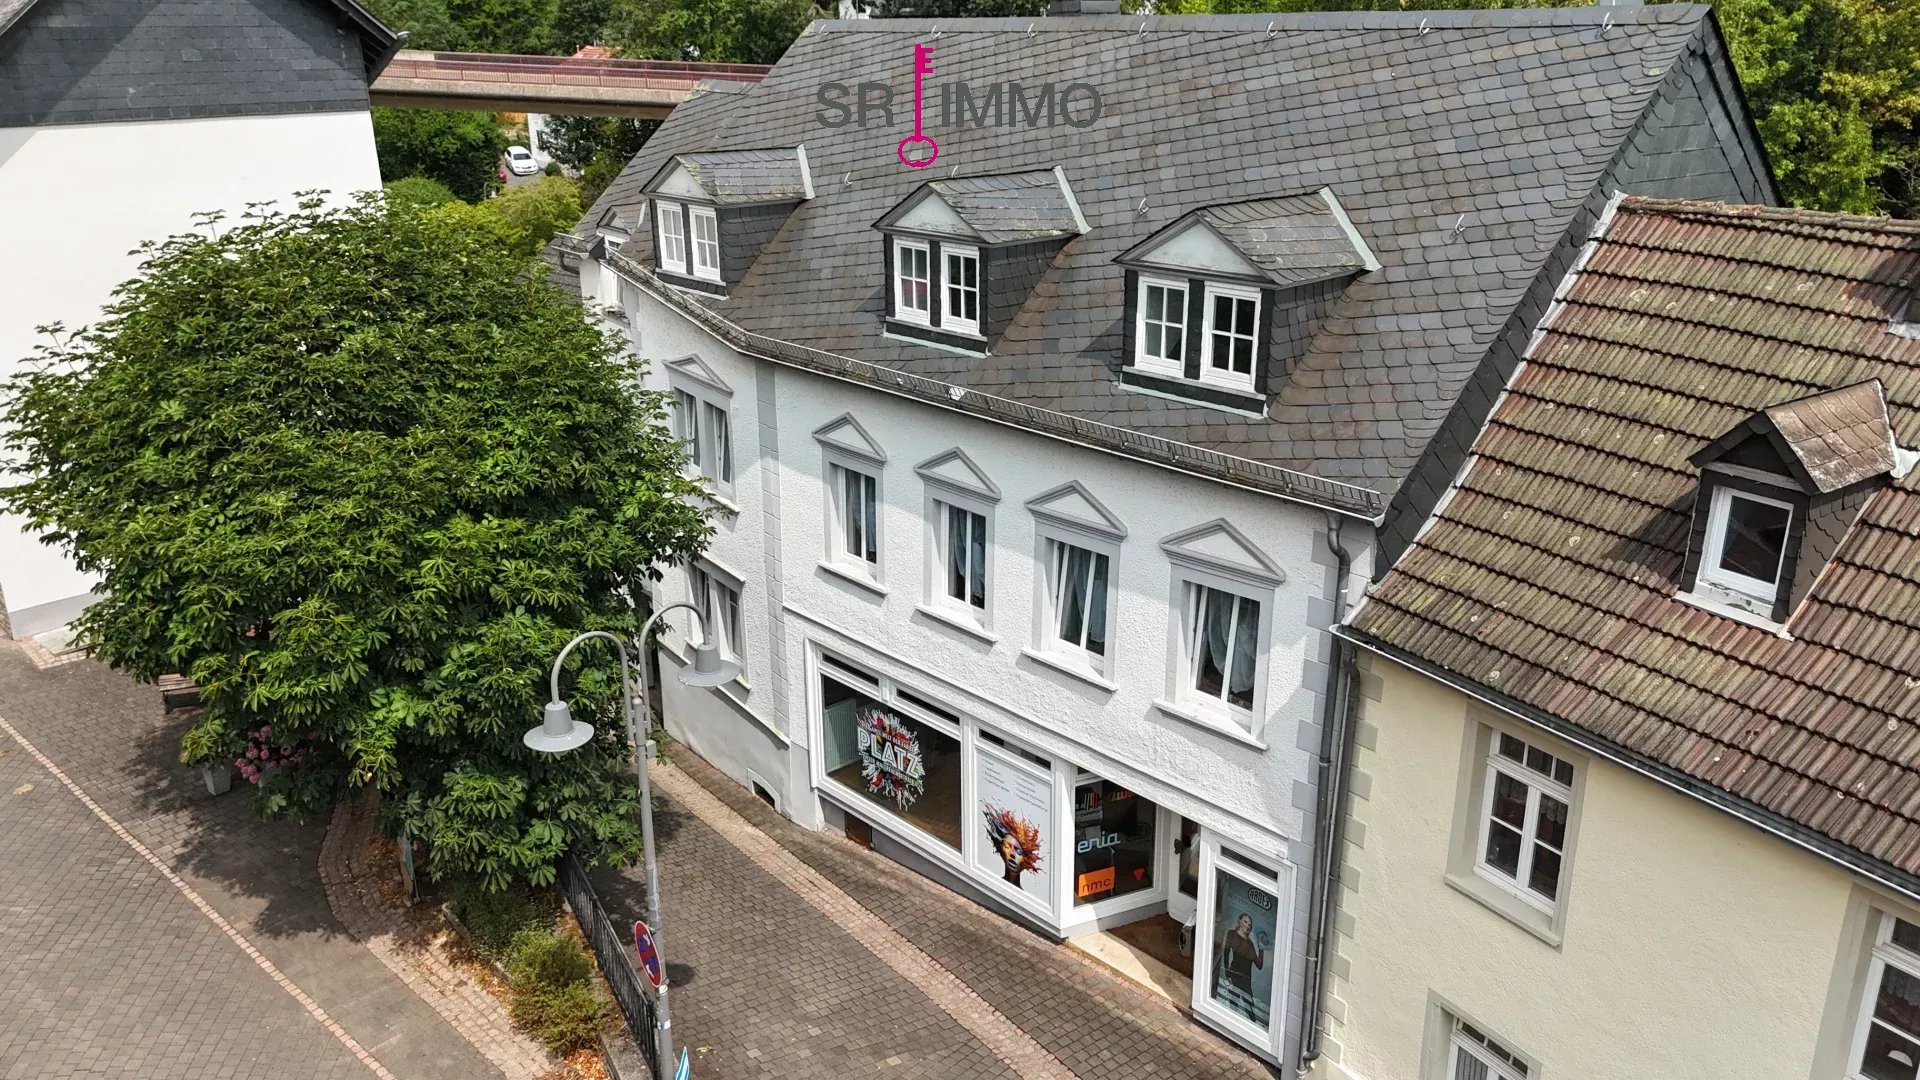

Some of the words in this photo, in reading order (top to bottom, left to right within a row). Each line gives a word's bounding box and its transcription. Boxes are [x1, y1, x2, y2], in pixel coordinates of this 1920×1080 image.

[857, 725, 919, 779] PLATZ
[1082, 878, 1112, 893] nmc
[1249, 888, 1271, 910] ARDEX
